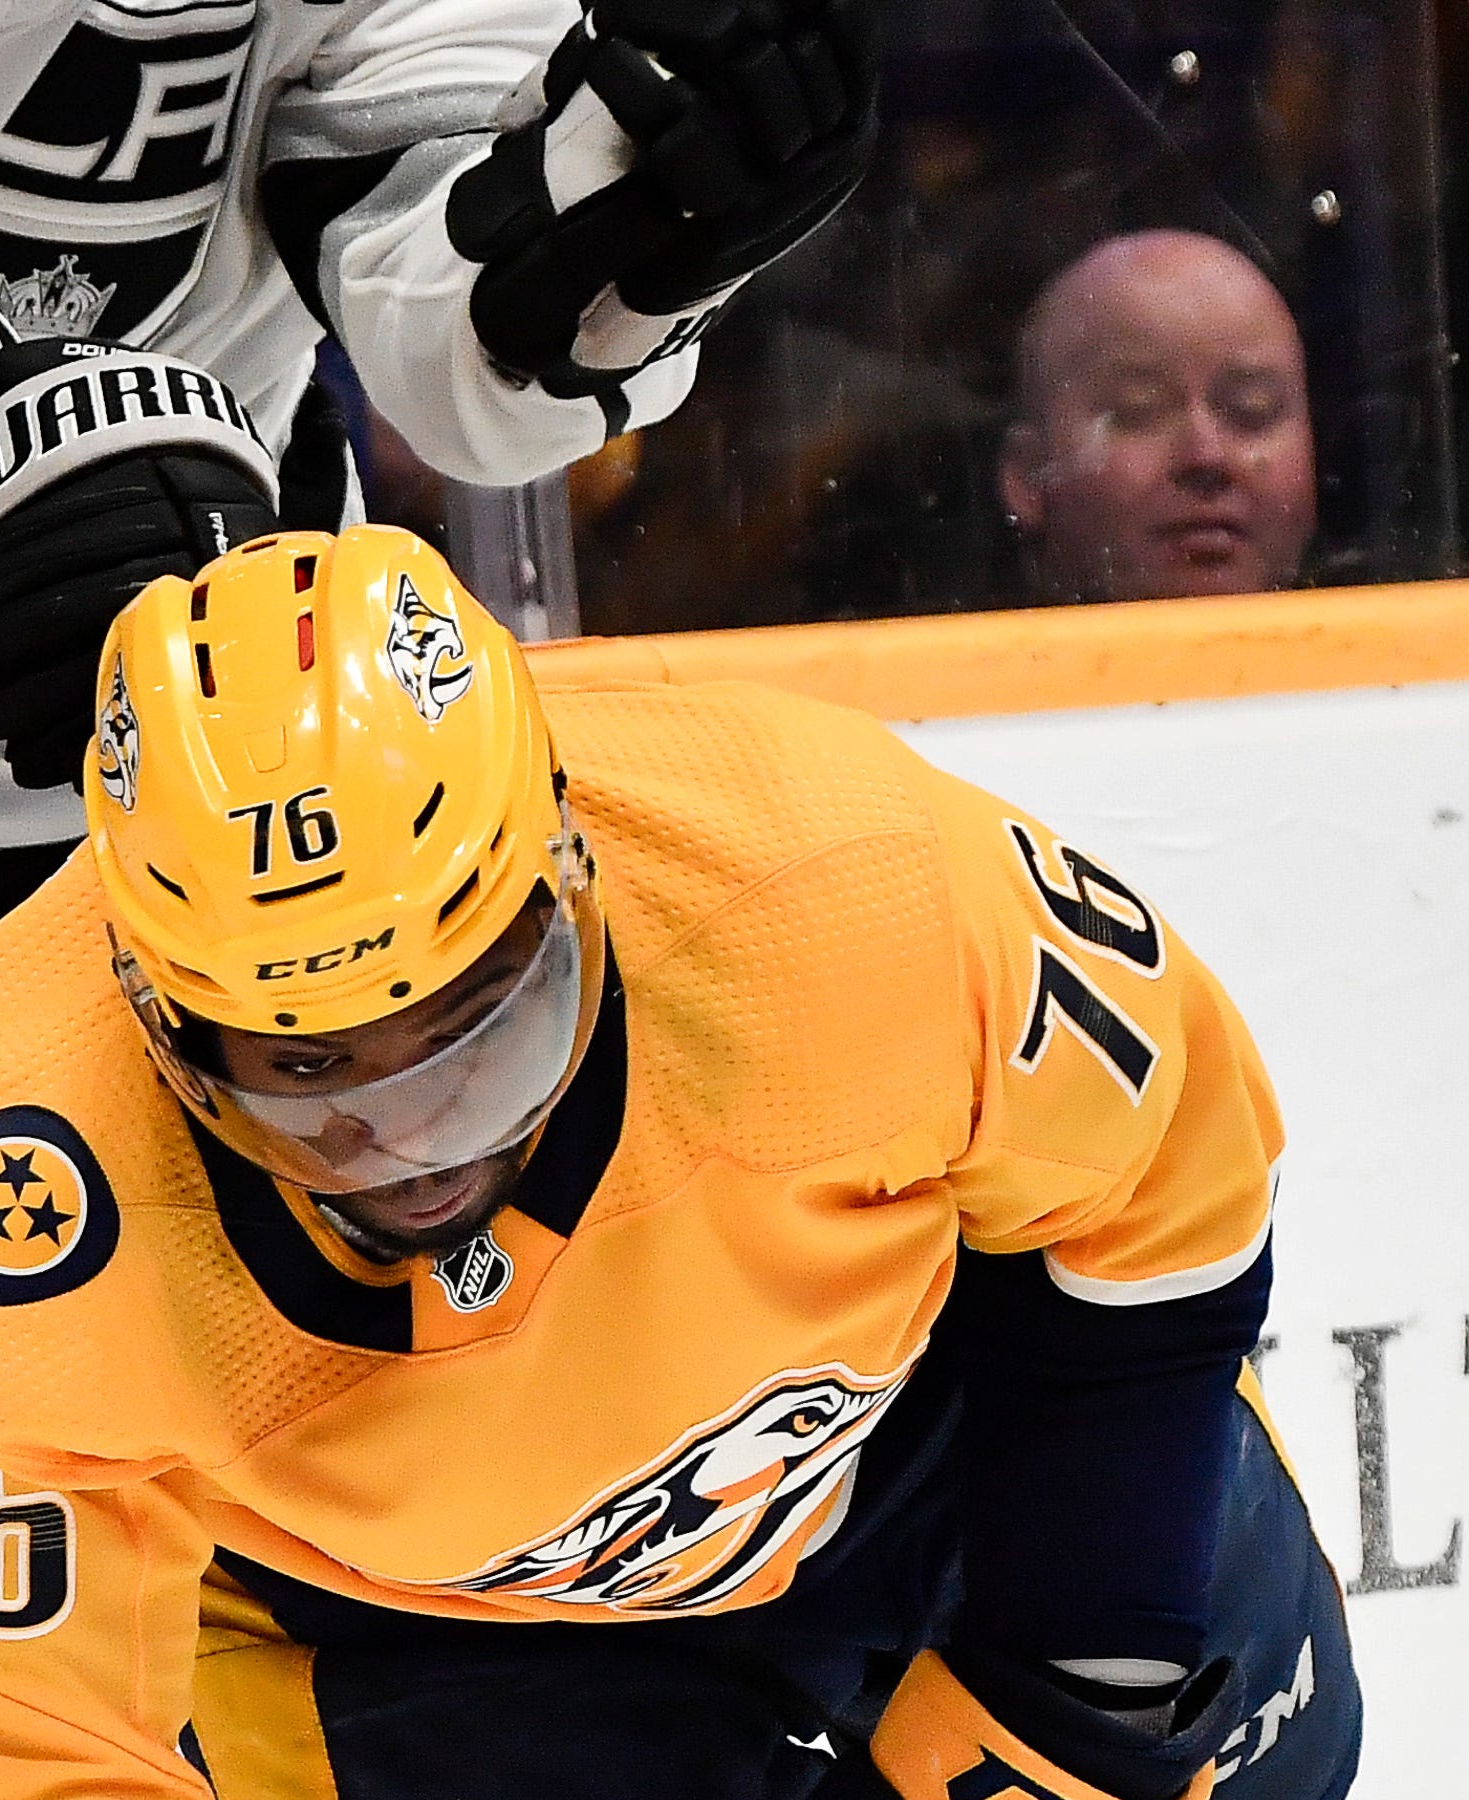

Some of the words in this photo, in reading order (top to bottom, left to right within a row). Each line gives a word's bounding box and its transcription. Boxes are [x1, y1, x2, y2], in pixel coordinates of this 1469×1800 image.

[61, 342, 129, 357] DOU
[228, 785, 342, 879] 76
[254, 926, 396, 980] CCM
[1001, 816, 1166, 1108] 76
[462, 1250, 490, 1301] NHL
